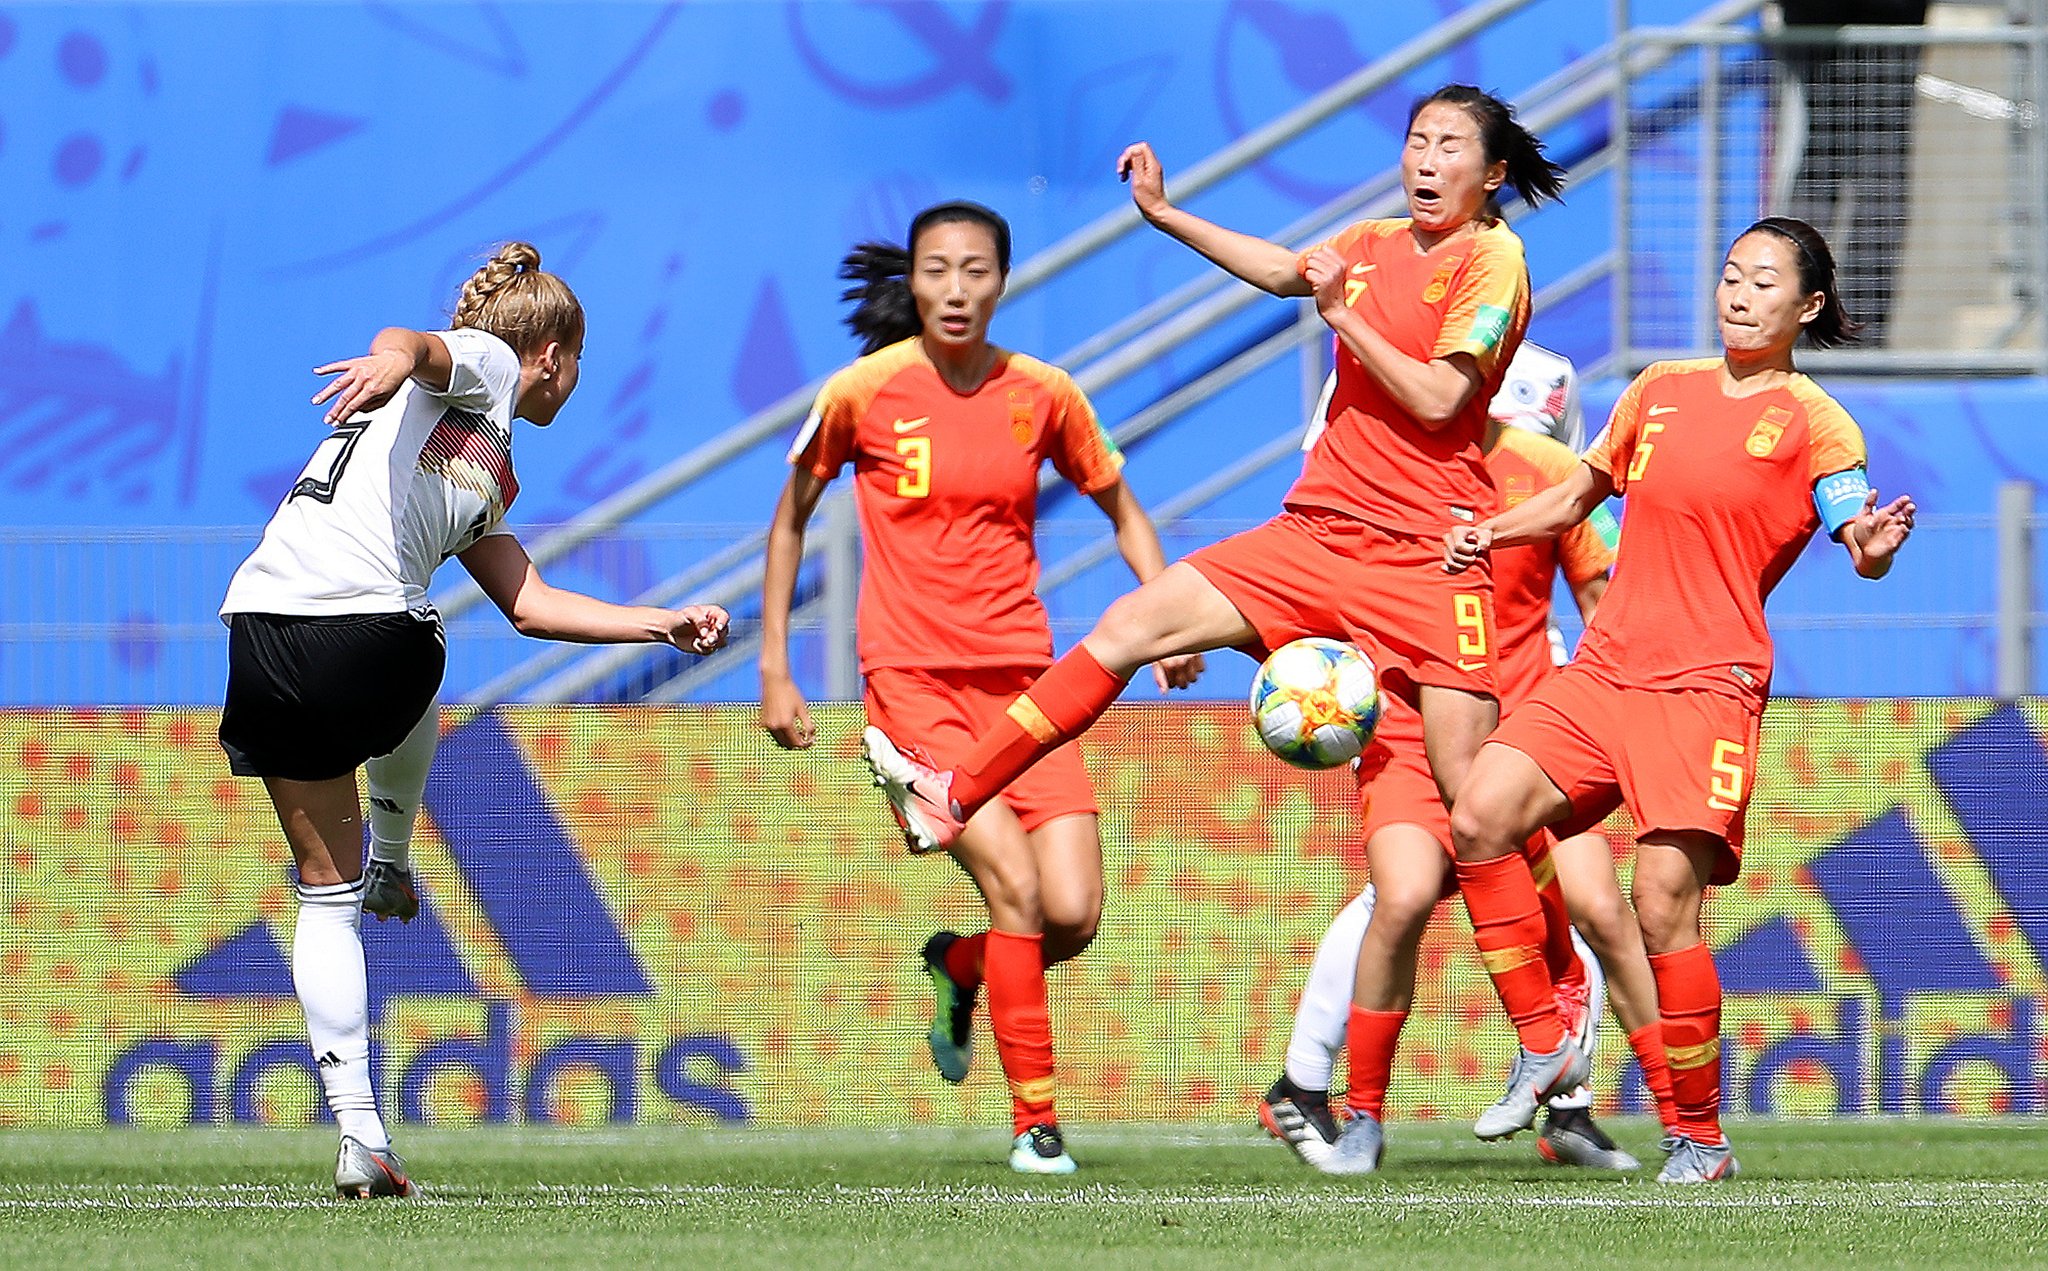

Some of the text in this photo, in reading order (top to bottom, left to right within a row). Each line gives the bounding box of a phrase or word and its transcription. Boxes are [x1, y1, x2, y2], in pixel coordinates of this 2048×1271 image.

[896, 437, 931, 498] 3
[1627, 422, 1665, 481] 5
[1453, 593, 1487, 656] 9
[1711, 738, 1745, 802] 5
